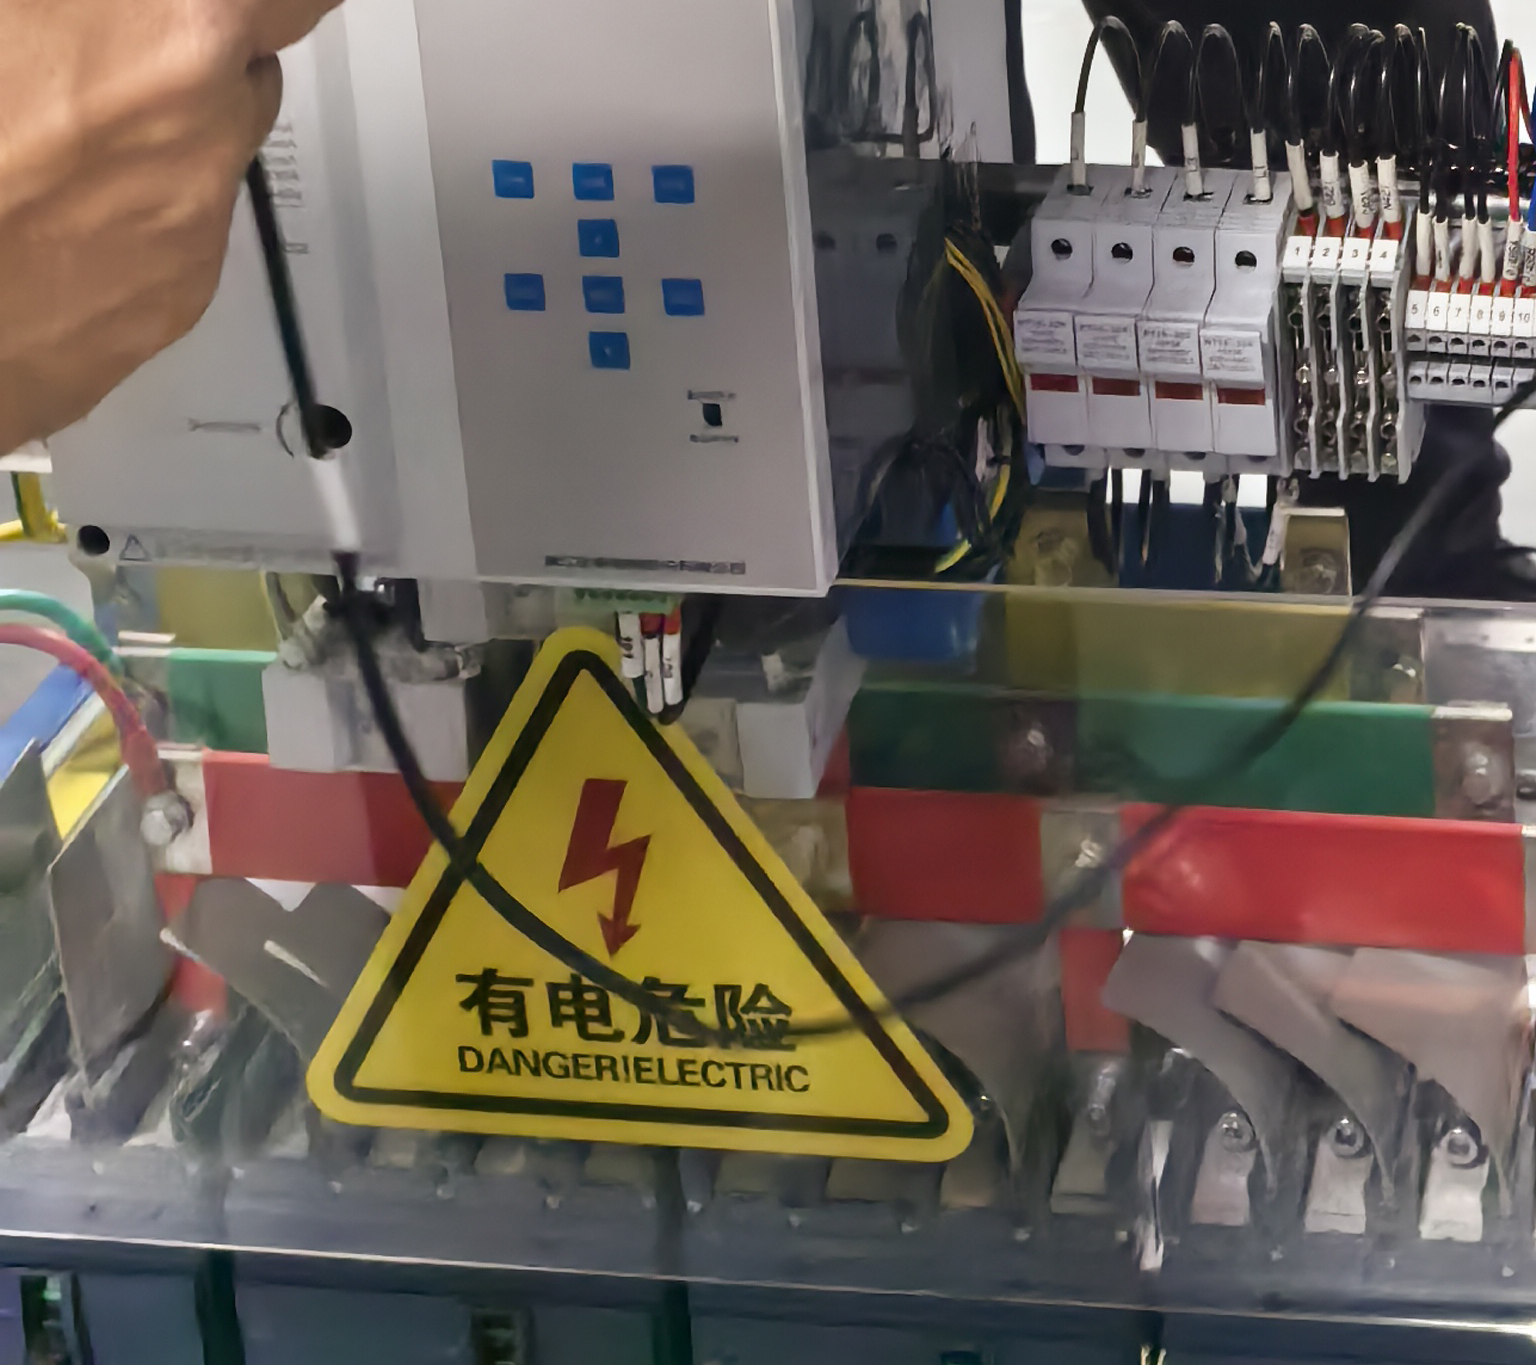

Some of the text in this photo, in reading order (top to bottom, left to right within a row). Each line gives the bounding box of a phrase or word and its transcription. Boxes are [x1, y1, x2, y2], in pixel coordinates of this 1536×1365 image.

[1518, 313, 1530, 324] 10
[455, 967, 797, 1052] 有电危险
